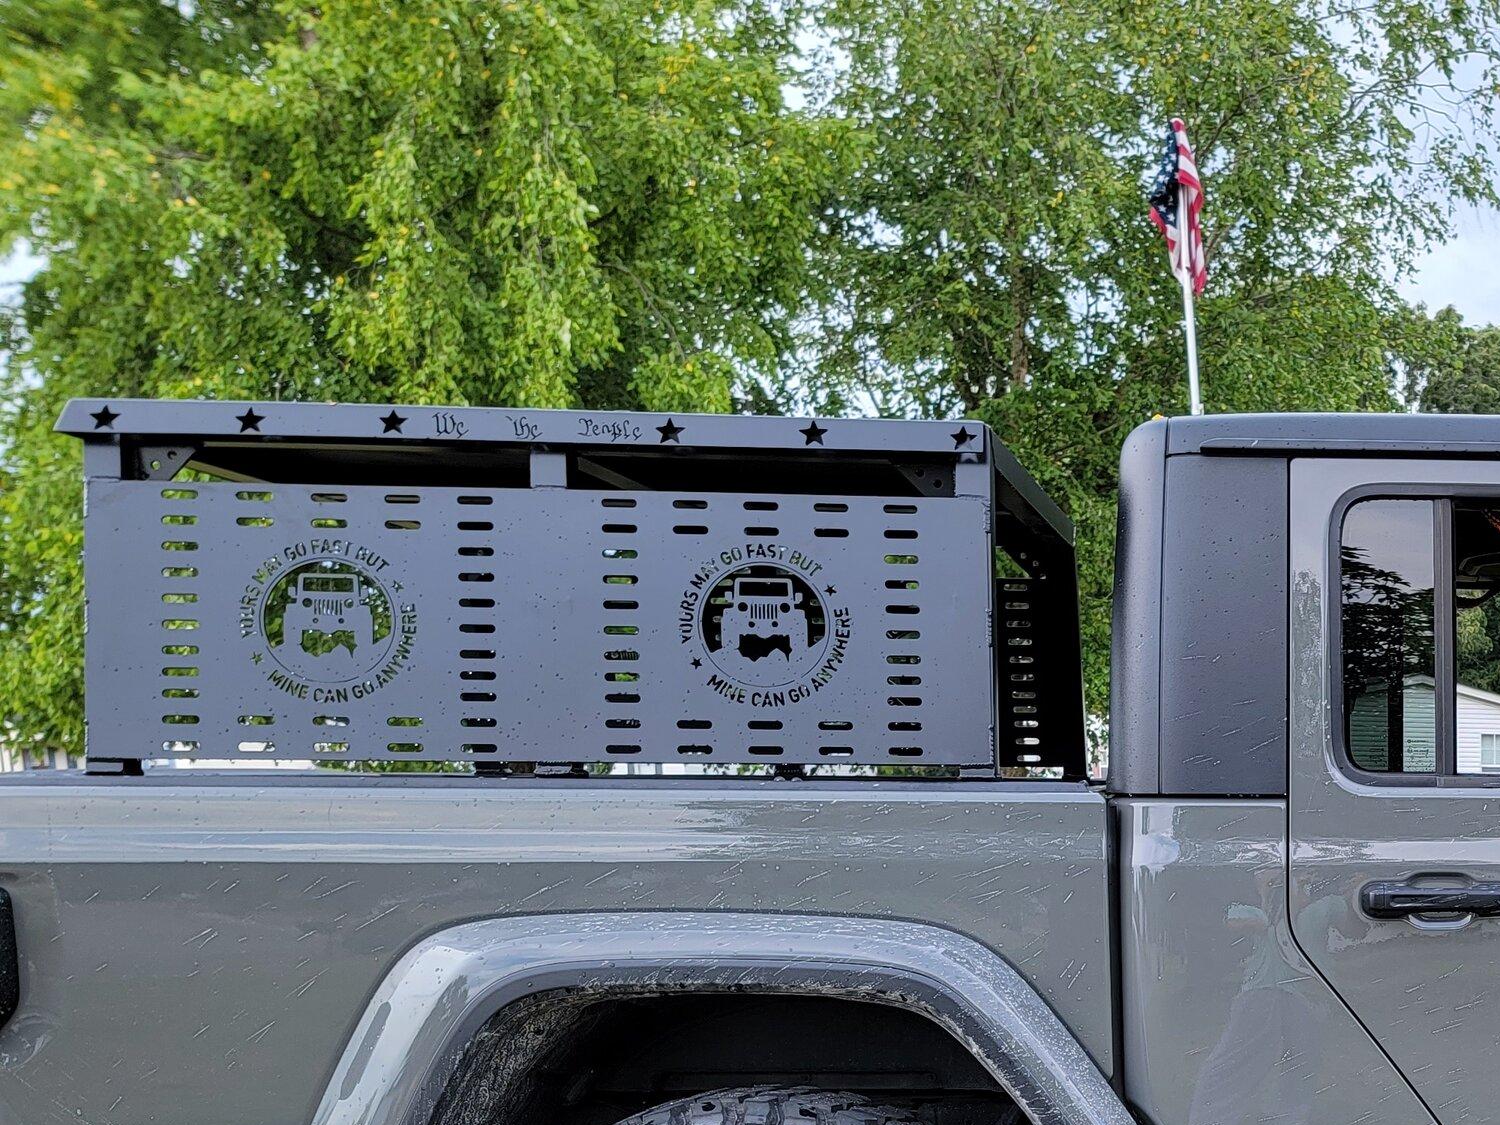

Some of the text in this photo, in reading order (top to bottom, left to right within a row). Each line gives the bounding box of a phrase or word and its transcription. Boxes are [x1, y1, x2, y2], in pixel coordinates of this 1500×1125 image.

[432, 412, 469, 438] We
[239, 539, 391, 640] YOURS MAY GO FAST BUT
[678, 543, 823, 645] YOURS MAY GO FAST BUT
[267, 602, 418, 703] MINE CAN GO ANYWHERE
[706, 606, 852, 708] MINE CAN GO ANYWHERE
